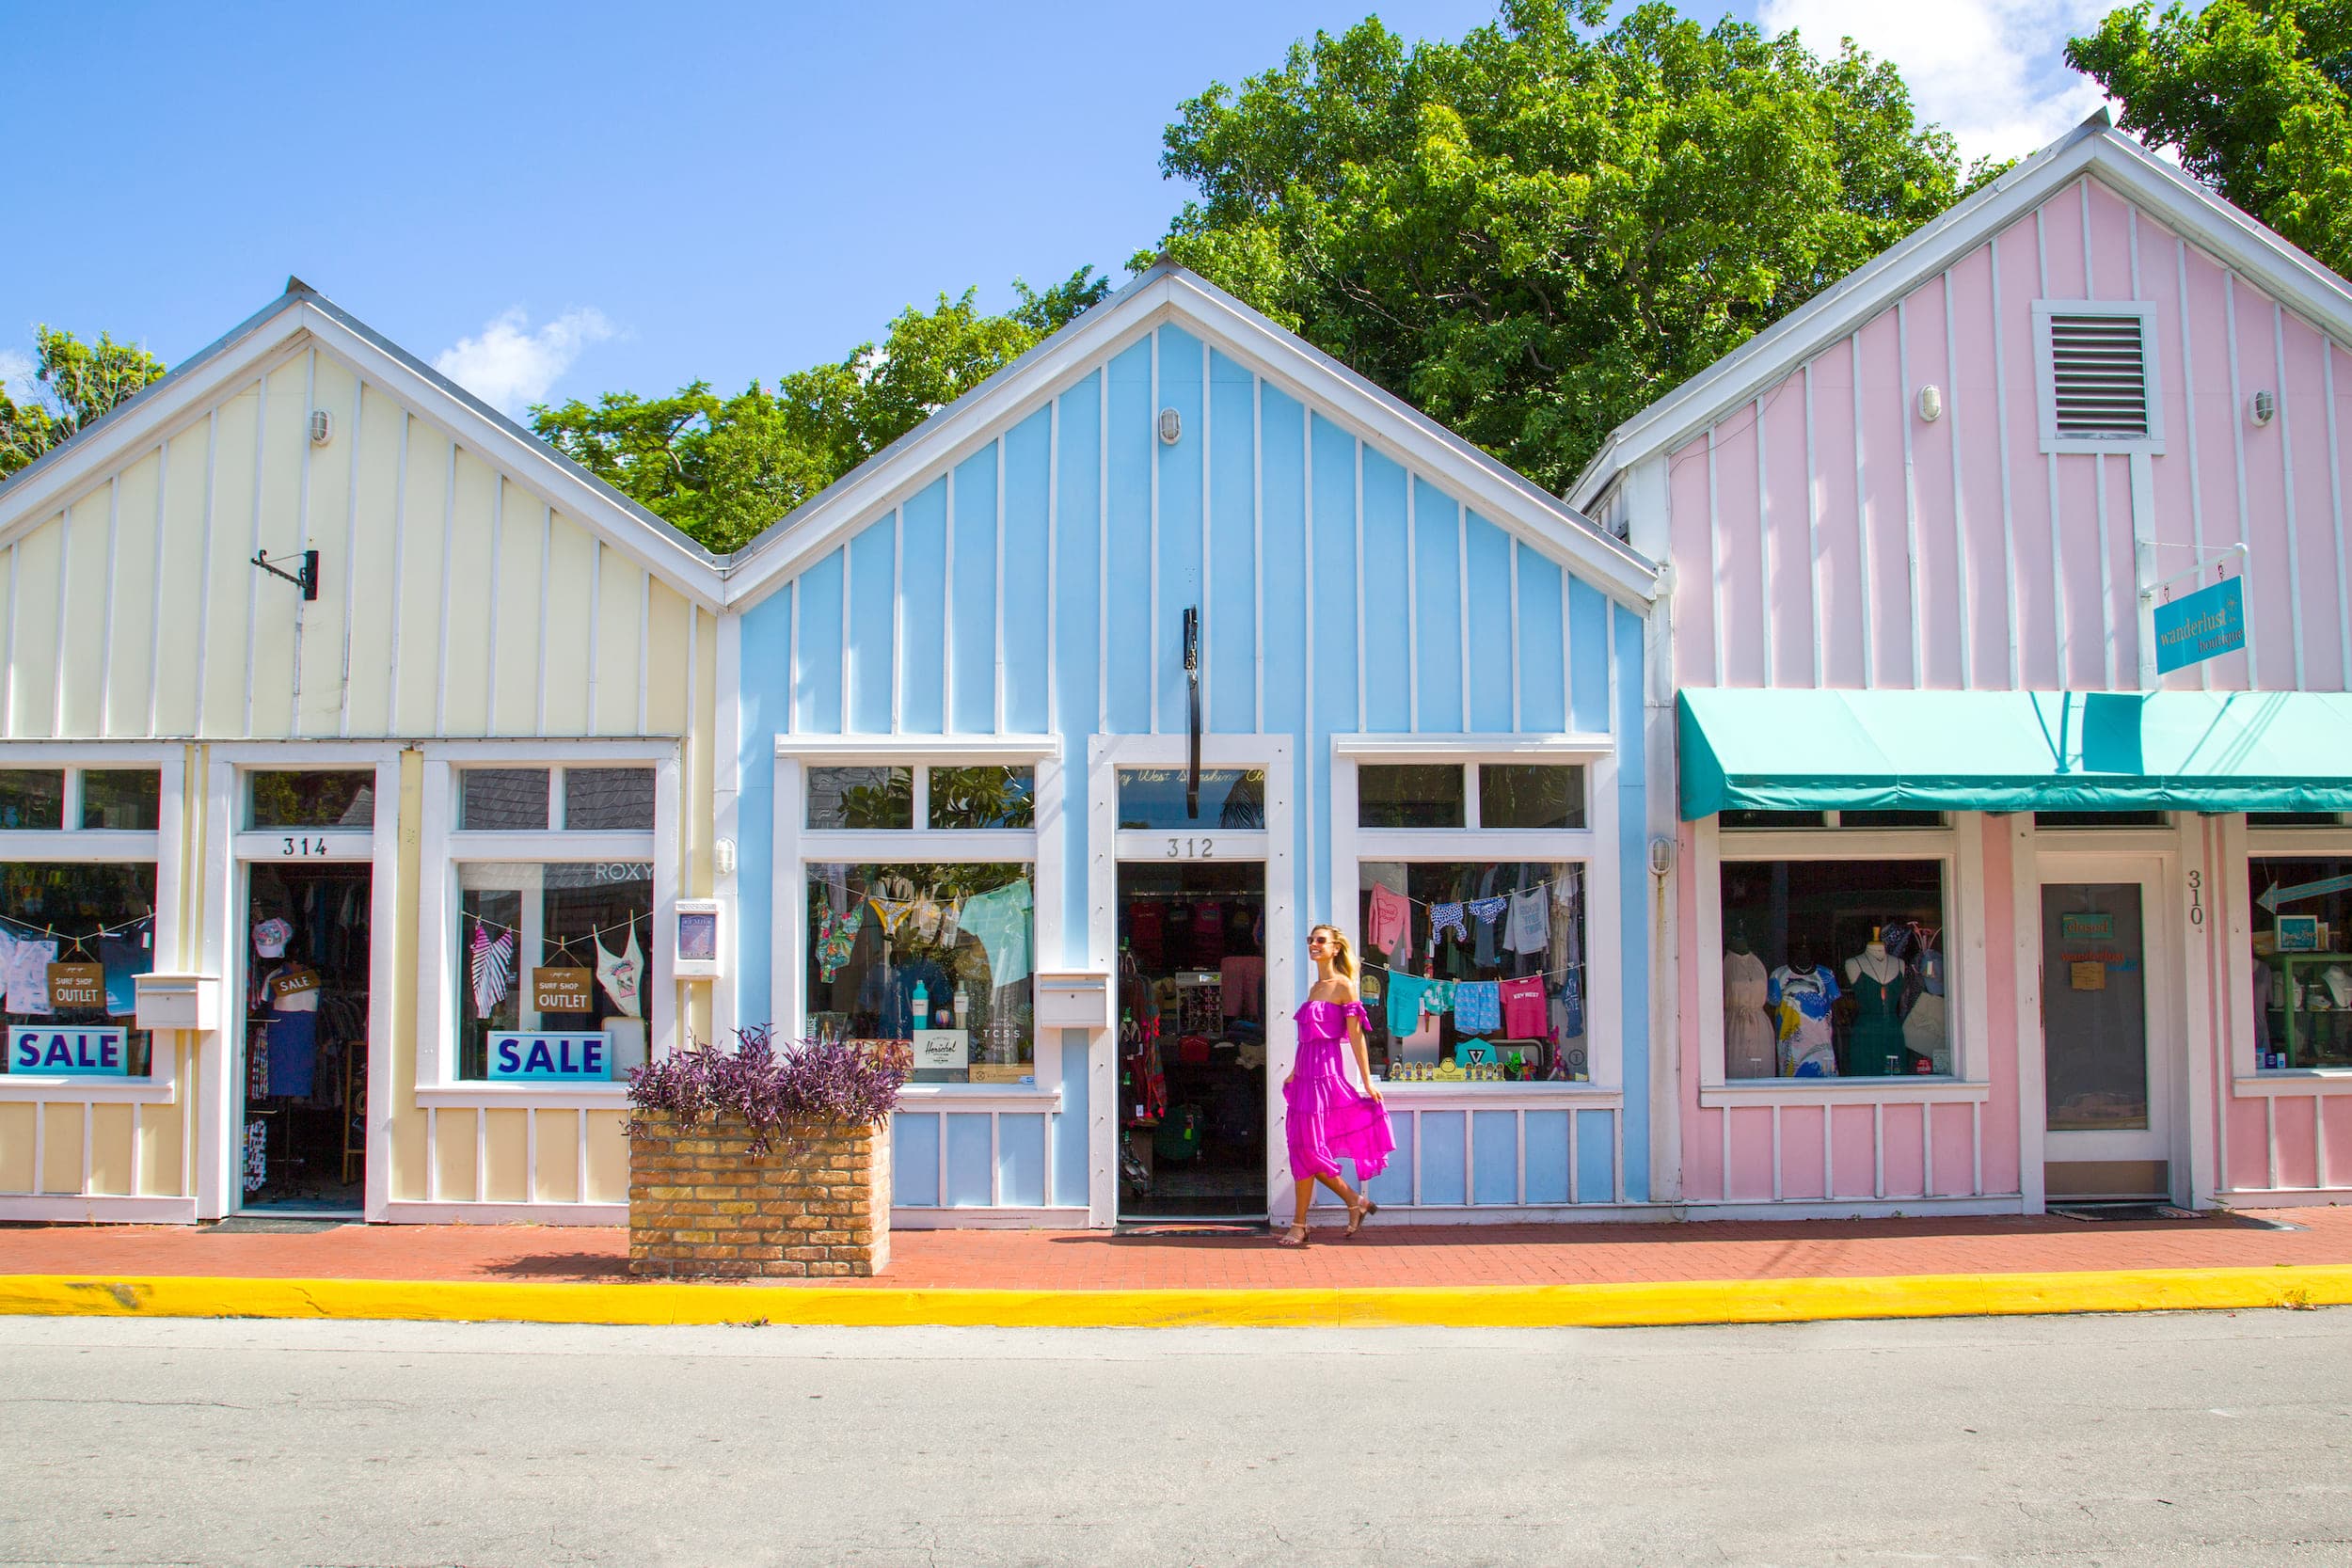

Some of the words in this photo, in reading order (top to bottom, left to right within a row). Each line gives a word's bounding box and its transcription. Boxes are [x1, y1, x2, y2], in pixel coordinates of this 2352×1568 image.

[2160, 609, 2227, 646] wanderlust
[2198, 627, 2244, 654] boutique
[284, 838, 326, 855] 314
[1167, 838, 1213, 858] 312
[596, 863, 653, 880] ROXY
[2188, 870, 2202, 925] 310
[280, 976, 310, 991] SALE
[539, 982, 557, 990] SURF
[56, 989, 98, 1002] OUTLET
[538, 994, 587, 1007] OUTLET
[19, 1034, 119, 1067] SALE
[498, 1038, 602, 1073] SALE
